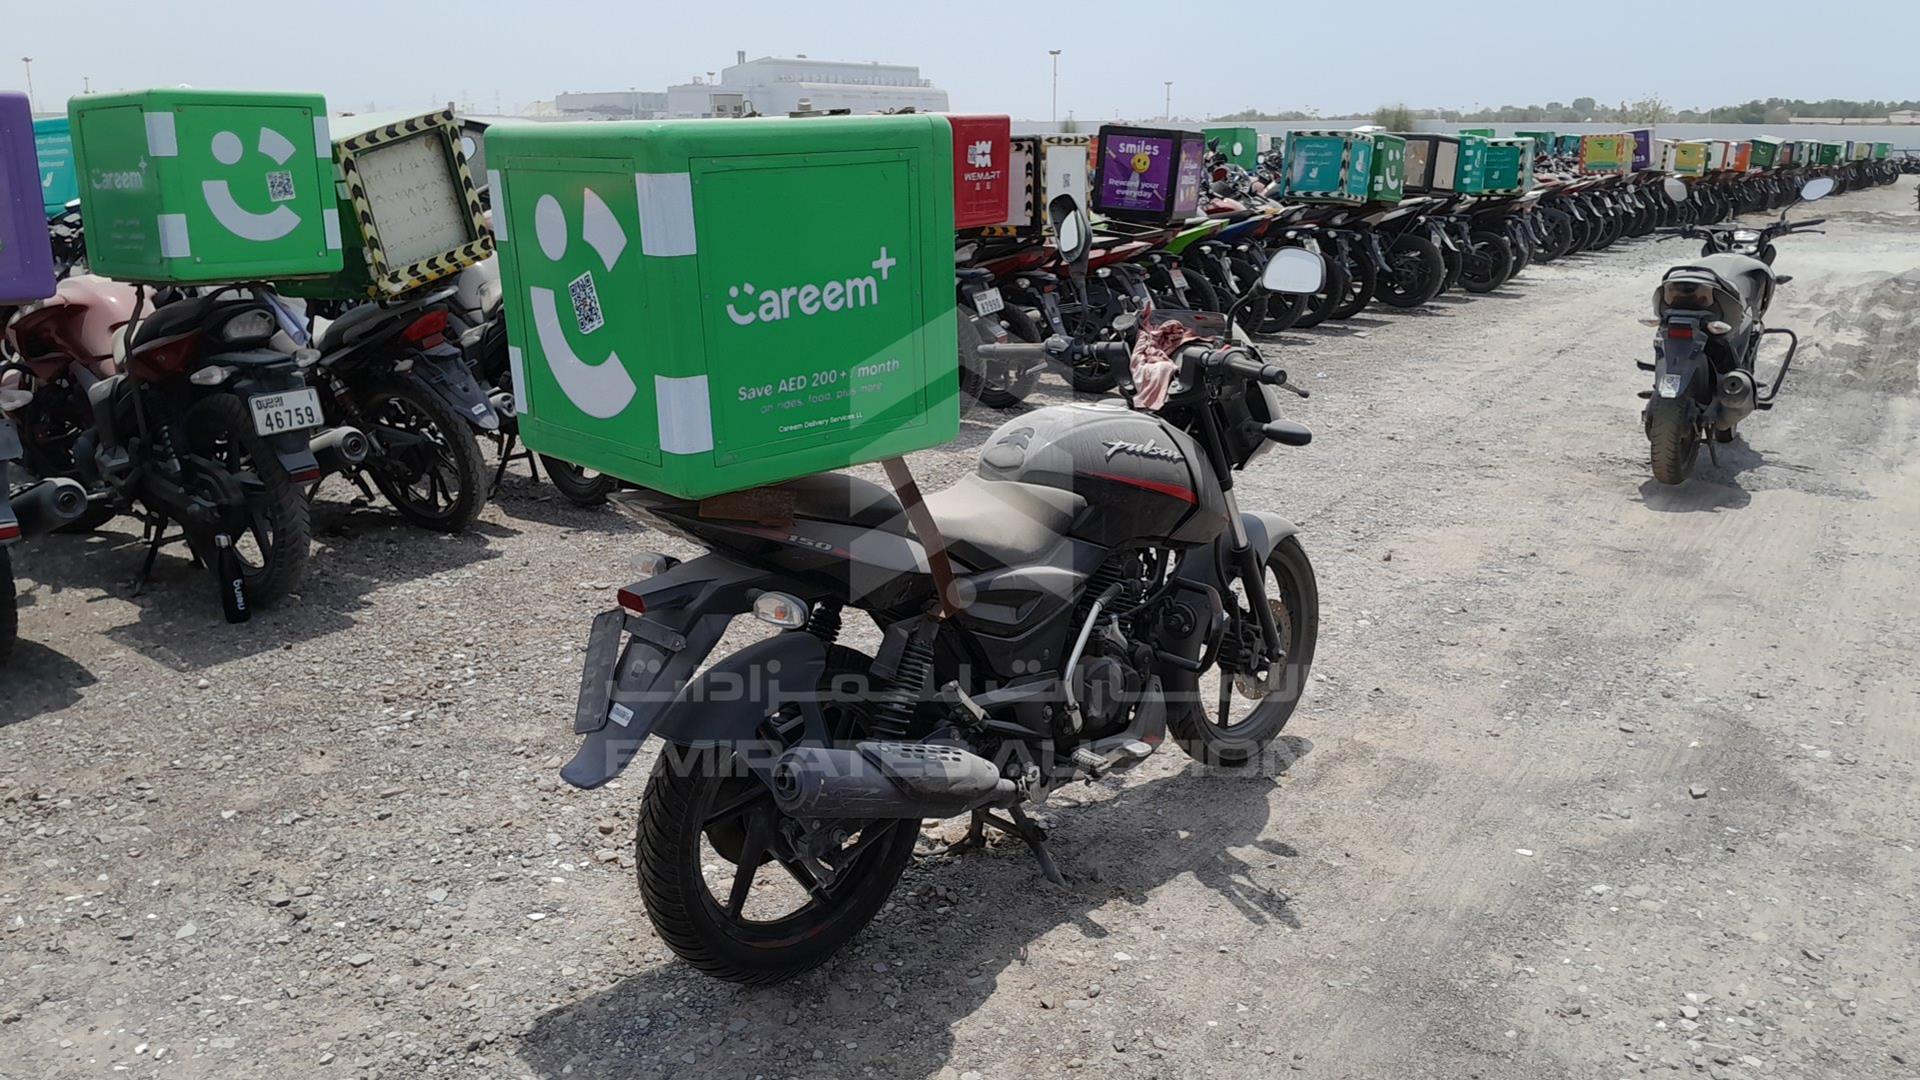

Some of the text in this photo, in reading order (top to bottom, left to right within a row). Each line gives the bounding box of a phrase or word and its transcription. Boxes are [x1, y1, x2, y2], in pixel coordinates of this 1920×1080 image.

[1118, 140, 1160, 156] smiles
[964, 170, 1001, 181] WEMART
[738, 384, 773, 401] Save
[778, 375, 807, 393] AED
[857, 358, 900, 378] month
[265, 406, 315, 432] 46759
[778, 422, 804, 433] Careem
[804, 419, 829, 429] Delivery
[788, 534, 833, 551] 150
